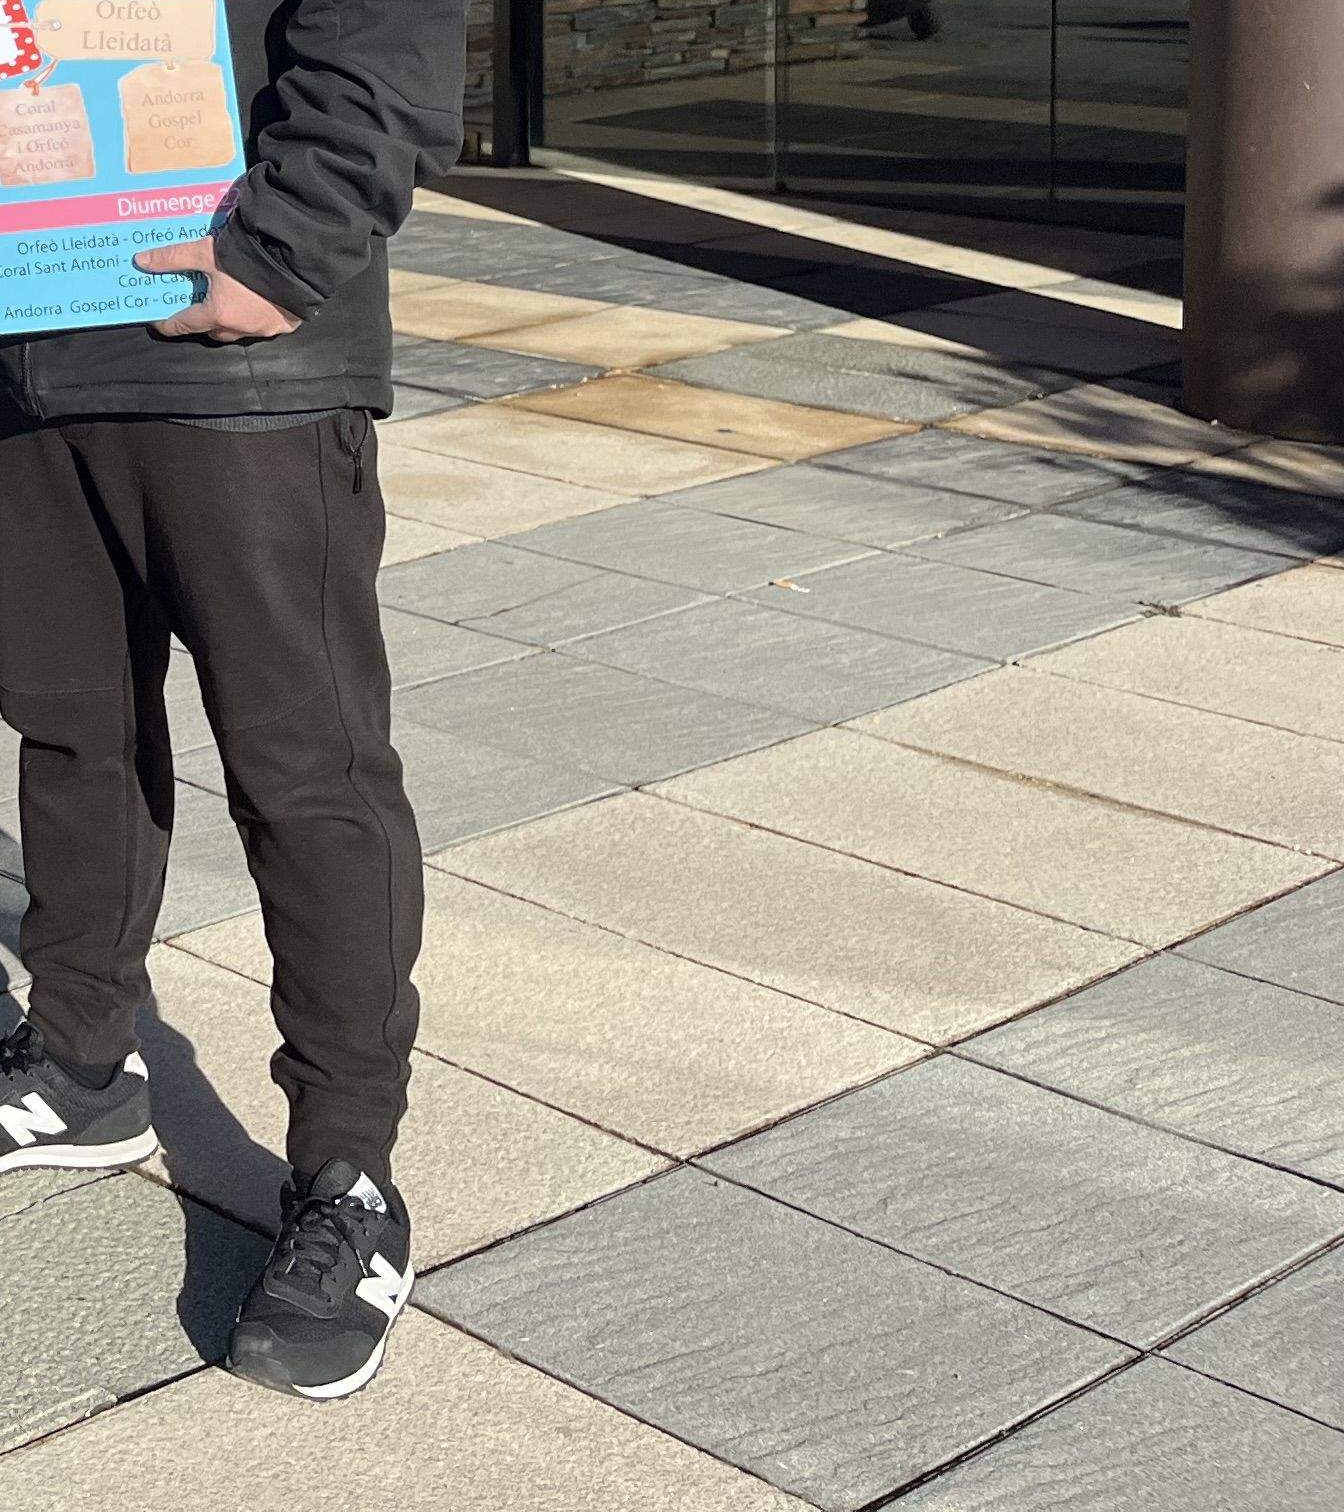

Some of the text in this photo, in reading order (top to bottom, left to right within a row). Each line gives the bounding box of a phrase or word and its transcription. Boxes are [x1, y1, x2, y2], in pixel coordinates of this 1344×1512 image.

[14, 99, 56, 116] Coral
[141, 89, 204, 107] Andorra
[147, 109, 202, 131] Gospel
[163, 135, 193, 151] Cor
[116, 189, 216, 221] Diumenge
[33, 260, 66, 275] Sant
[69, 254, 119, 272] Antoni
[117, 272, 155, 288] Coral
[2, 303, 61, 320] Andorra
[68, 296, 119, 315] Gospel
[122, 294, 148, 309] Cor
